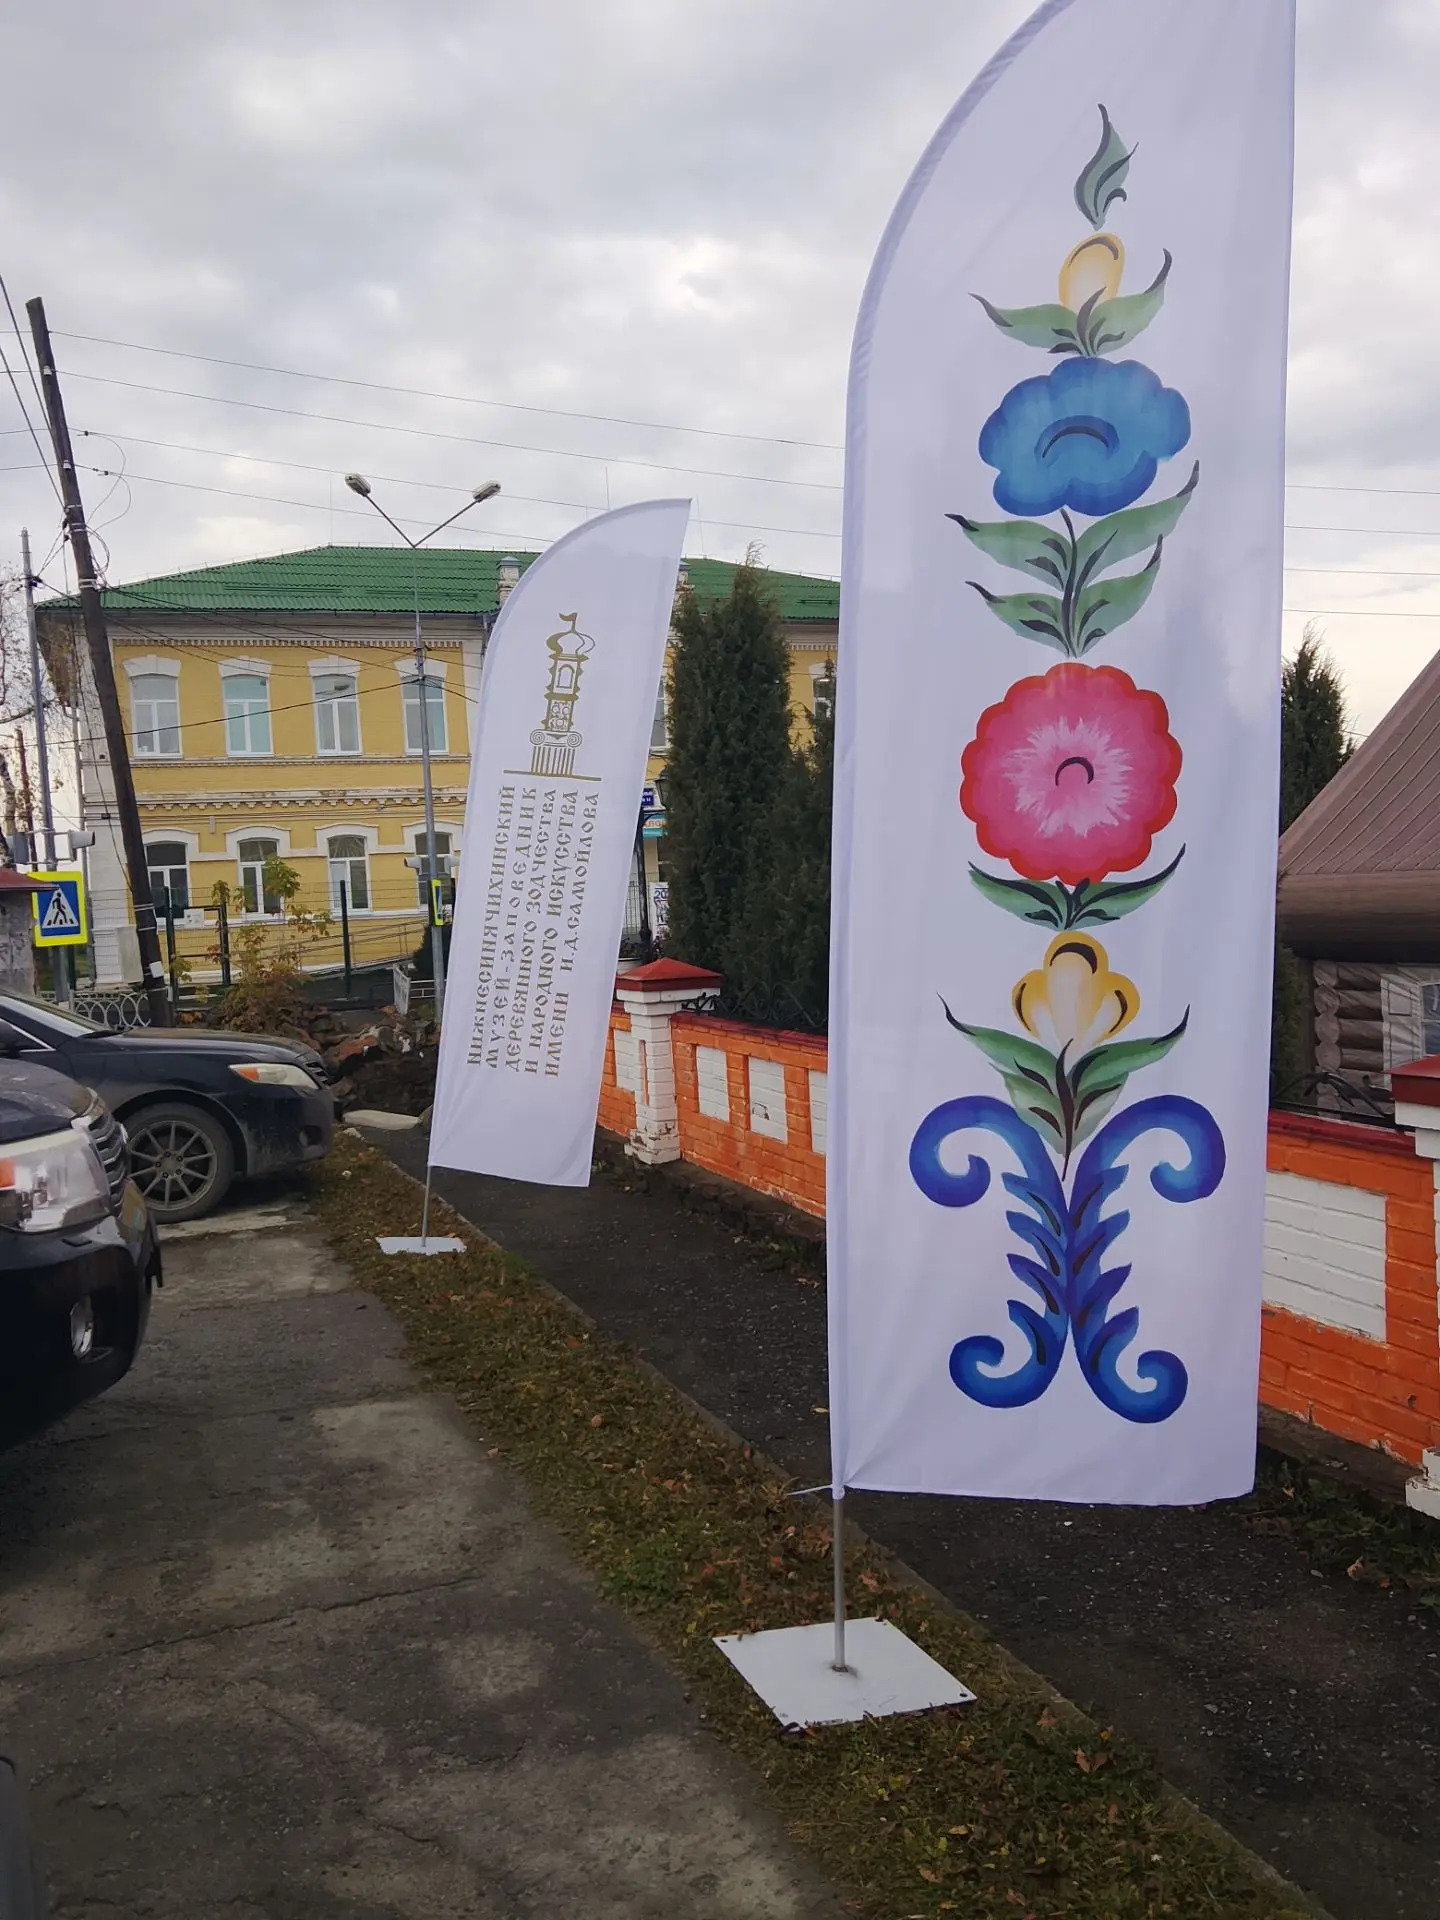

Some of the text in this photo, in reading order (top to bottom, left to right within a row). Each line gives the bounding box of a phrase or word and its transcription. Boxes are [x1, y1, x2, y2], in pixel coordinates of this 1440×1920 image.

[466, 785, 515, 1066] НИЖНЕСИНЯЧИХИНСКИЙ
[485, 787, 536, 1069] МУЗЕЙ-ЗАПОВЕДНИК
[505, 789, 556, 1072] ДЕРЕВЯННОГО ЗОДЧЕСТВА
[524, 789, 578, 1074] И НАРОДНОГО ИСКУССТВА
[545, 992, 568, 1077] ИМЕНИ
